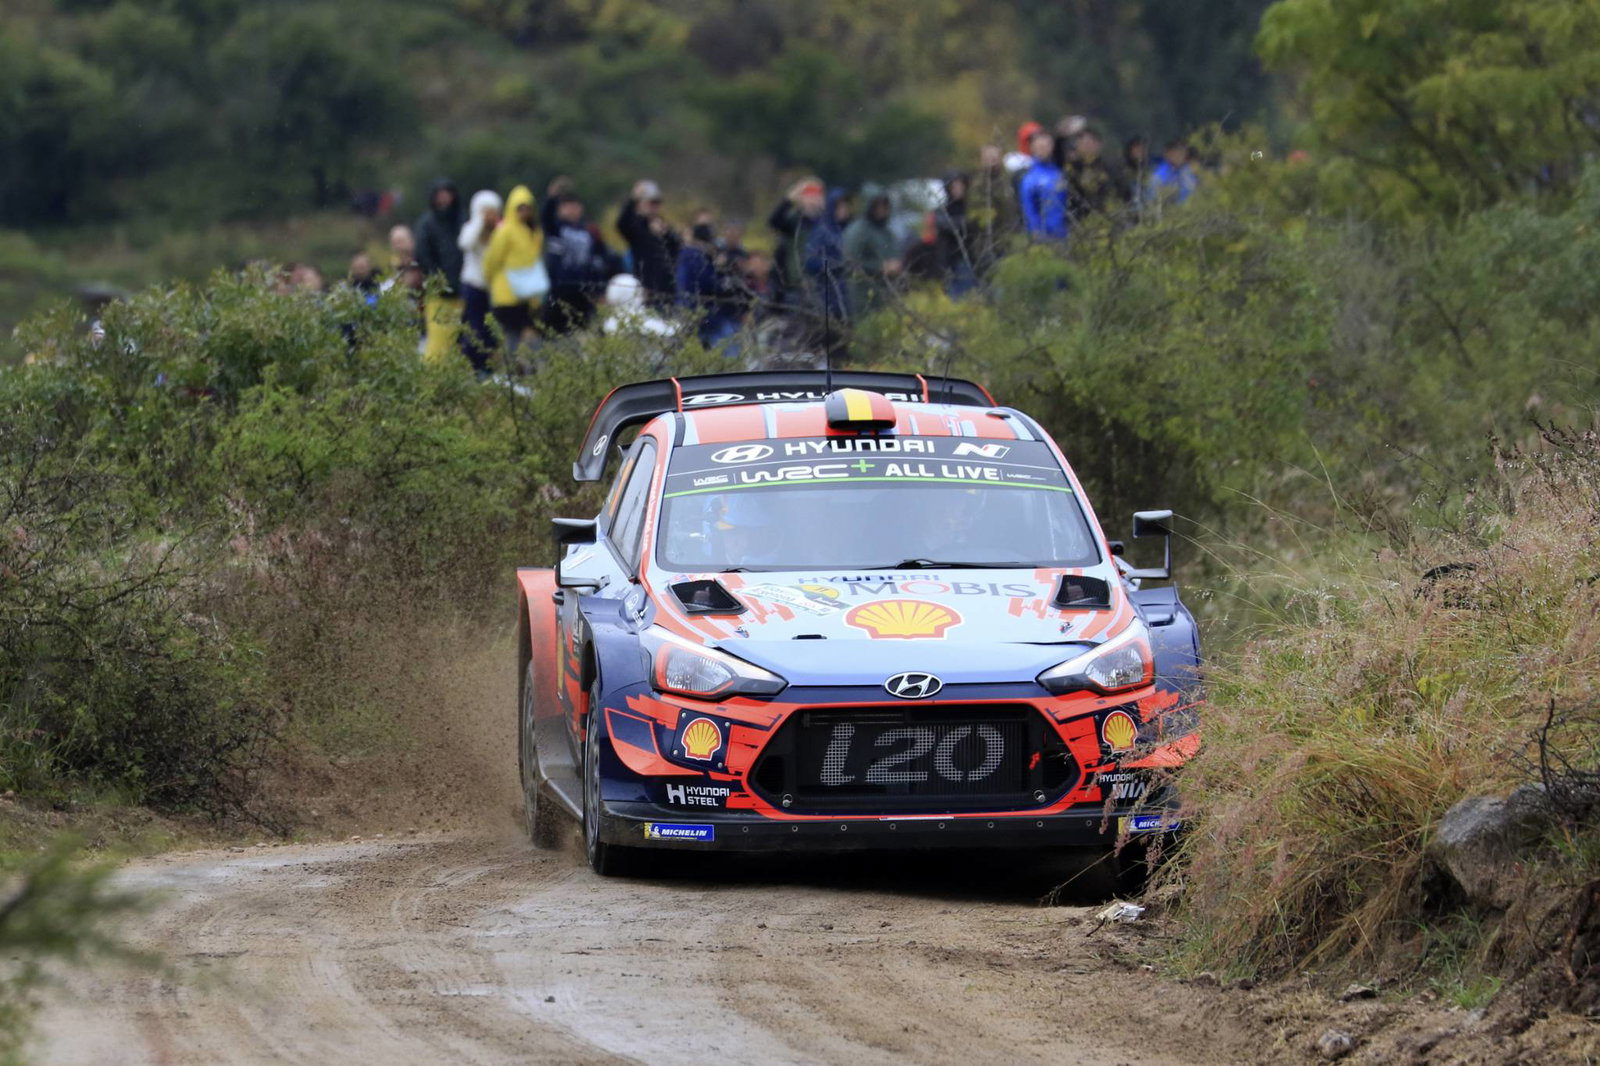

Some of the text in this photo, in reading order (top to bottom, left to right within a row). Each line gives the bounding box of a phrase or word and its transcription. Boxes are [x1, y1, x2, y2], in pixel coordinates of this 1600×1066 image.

[756, 391, 919, 402] HYUAI
[785, 439, 935, 456] HYUNDAI
[885, 463, 935, 477] ALL
[941, 465, 1000, 481] LIVE
[798, 574, 939, 584] HYUNDAI
[850, 581, 1036, 597] MOBIS
[686, 786, 730, 797] HYUNDAI
[687, 796, 719, 806] STEEL
[661, 829, 707, 837] MICHELIN
